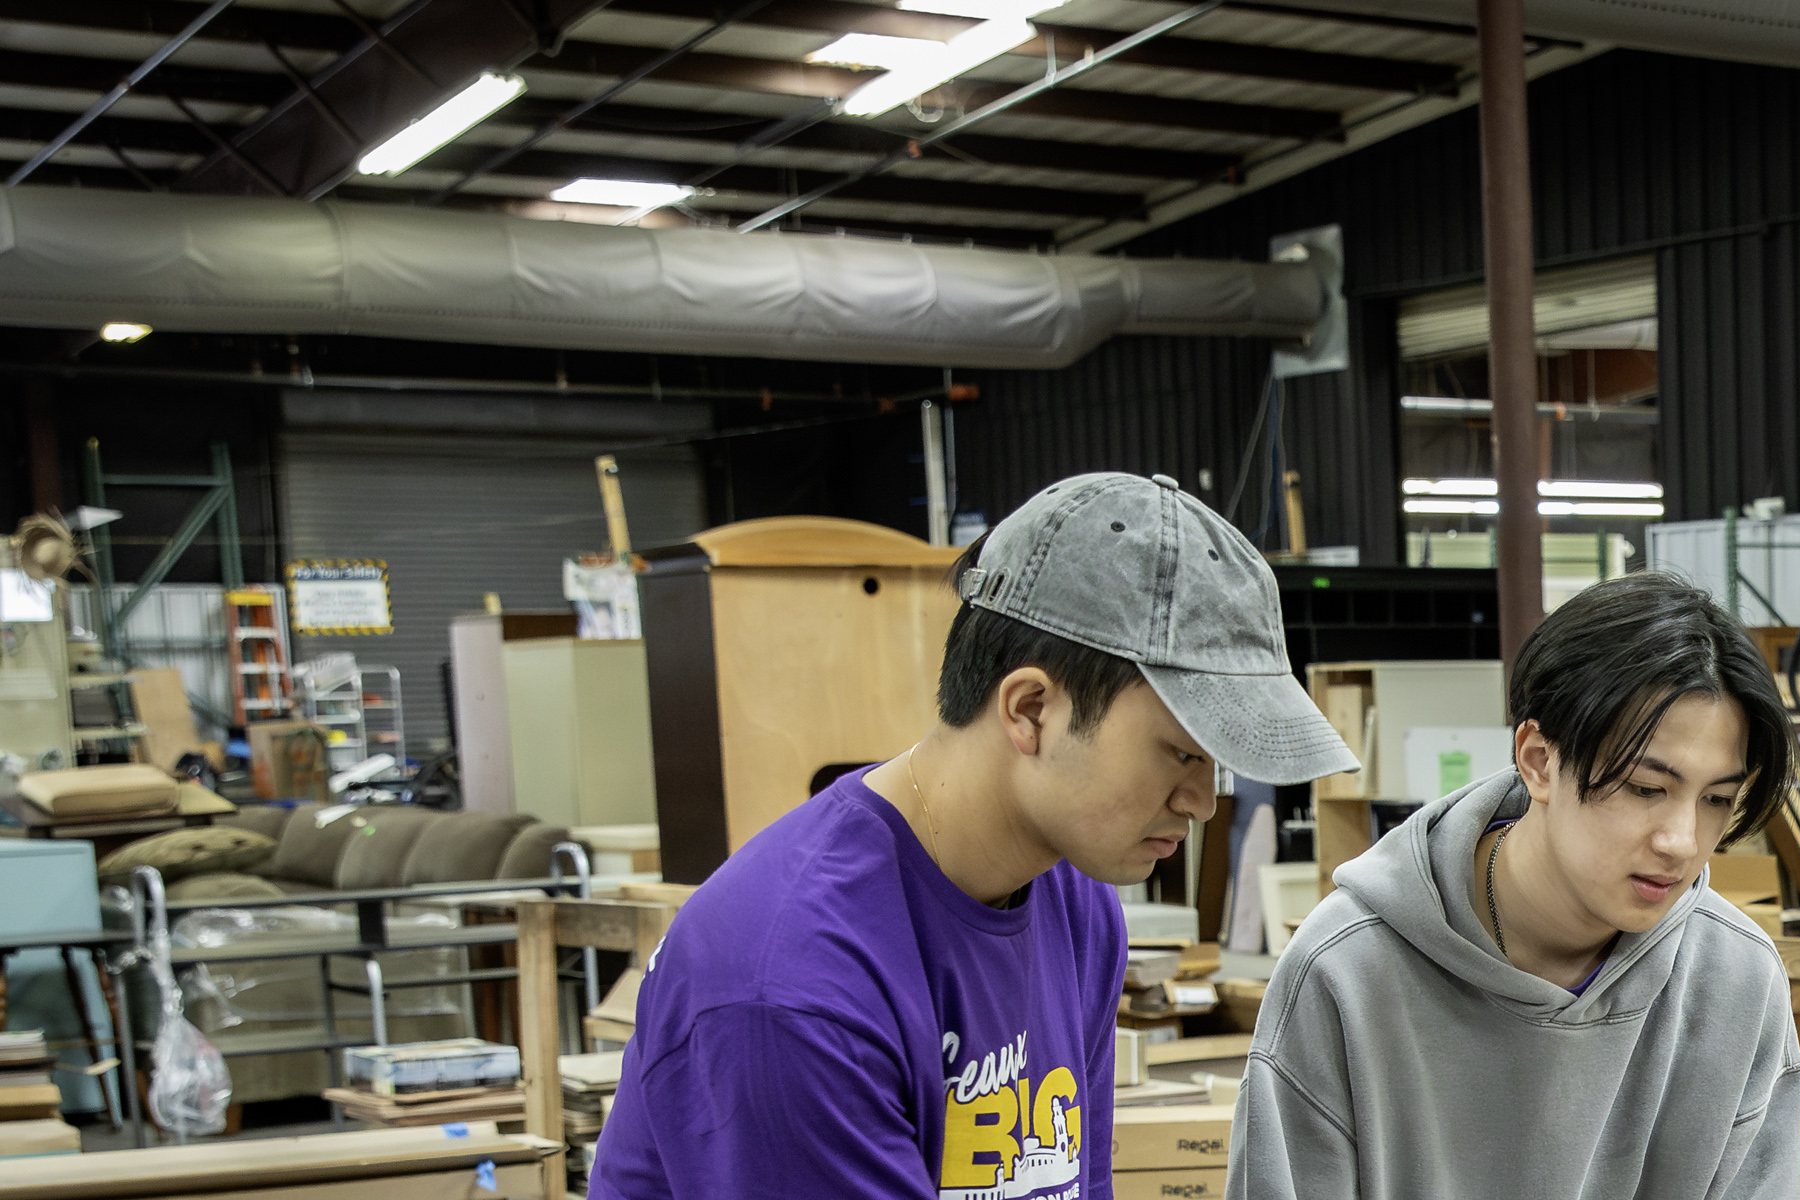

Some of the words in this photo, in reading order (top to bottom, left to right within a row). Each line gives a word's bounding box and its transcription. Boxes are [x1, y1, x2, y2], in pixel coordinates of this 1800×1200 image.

[940, 1066, 1081, 1187] BIG
[1177, 1138, 1224, 1155] Regal
[1161, 1183, 1208, 1199] Regal
